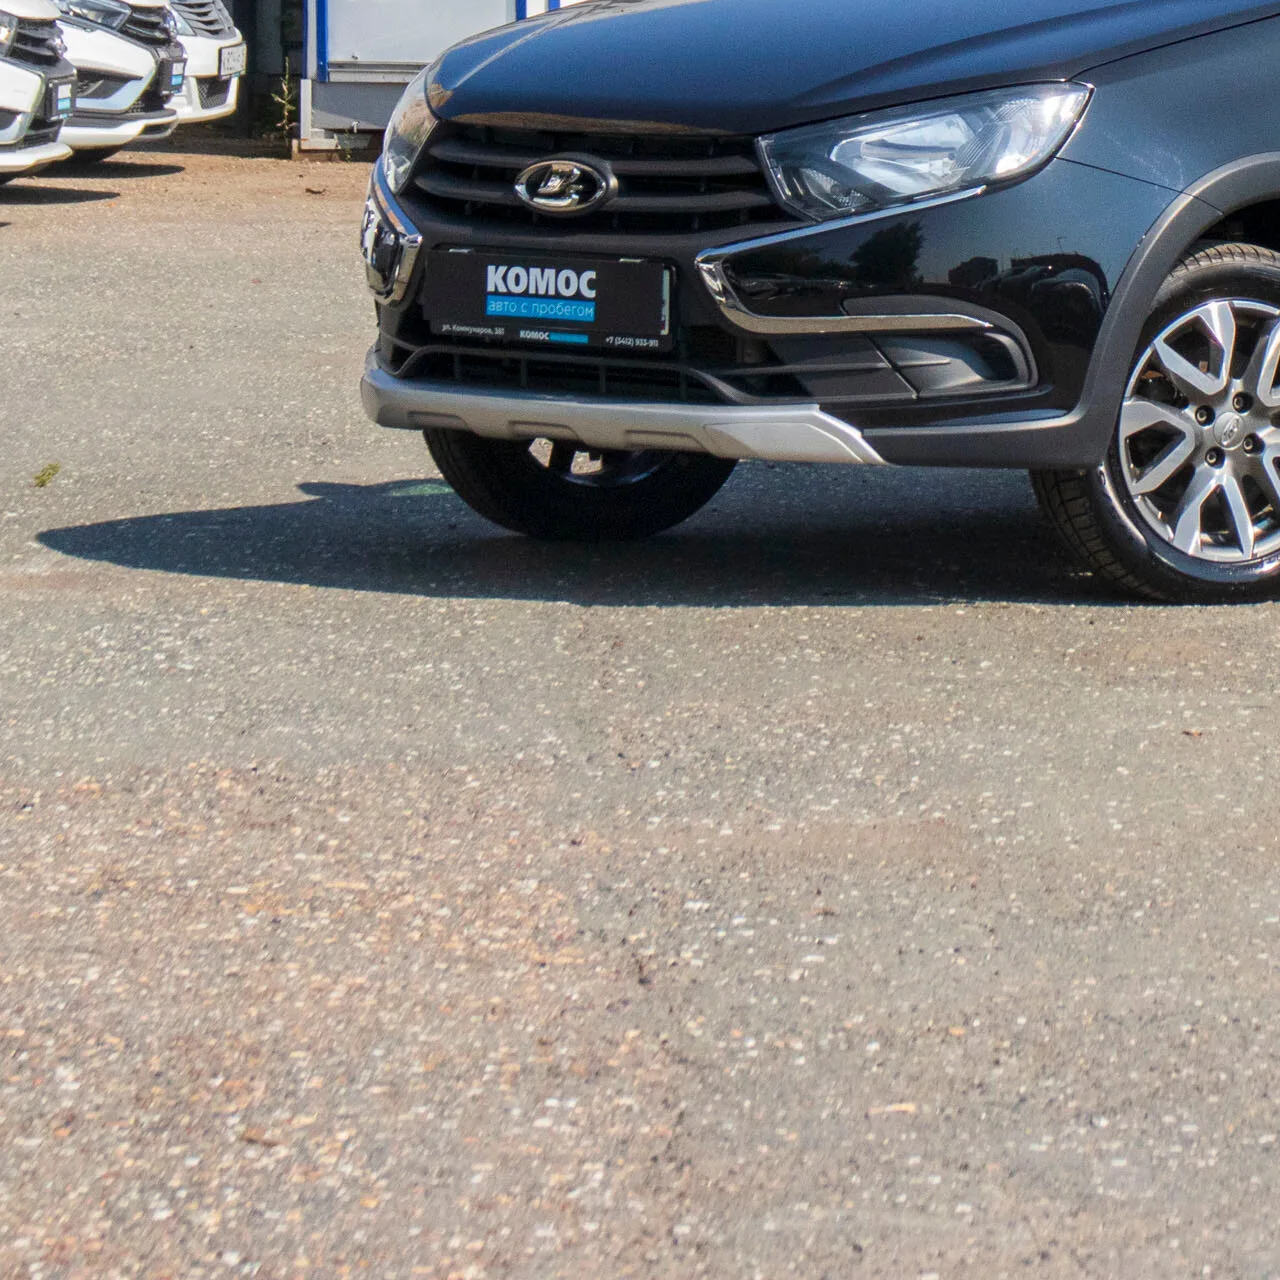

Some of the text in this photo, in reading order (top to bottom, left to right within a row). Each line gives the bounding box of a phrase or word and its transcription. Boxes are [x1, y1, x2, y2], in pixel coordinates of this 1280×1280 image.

[487, 265, 597, 298] КОМОС
[488, 301, 594, 317] авто с пробегом
[520, 329, 550, 340] КОМОС
